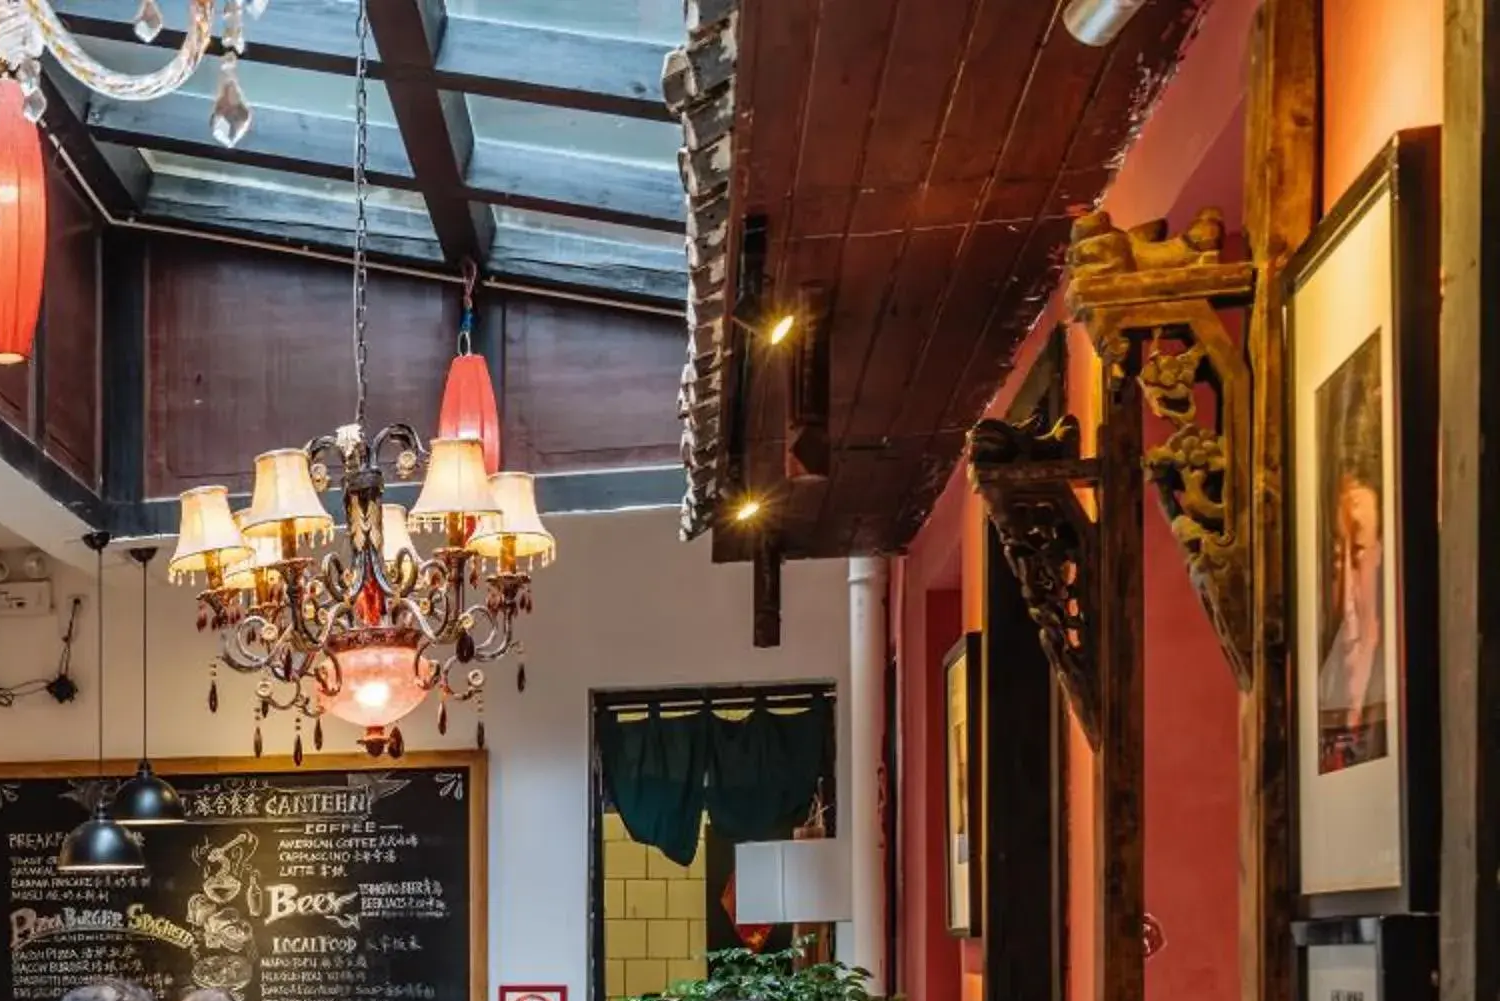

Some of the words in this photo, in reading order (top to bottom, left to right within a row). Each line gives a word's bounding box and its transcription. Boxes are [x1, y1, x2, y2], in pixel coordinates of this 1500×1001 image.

[265, 793, 366, 816] CANTEEN
[304, 822, 376, 835] COFFEE
[264, 883, 357, 927] Beer
